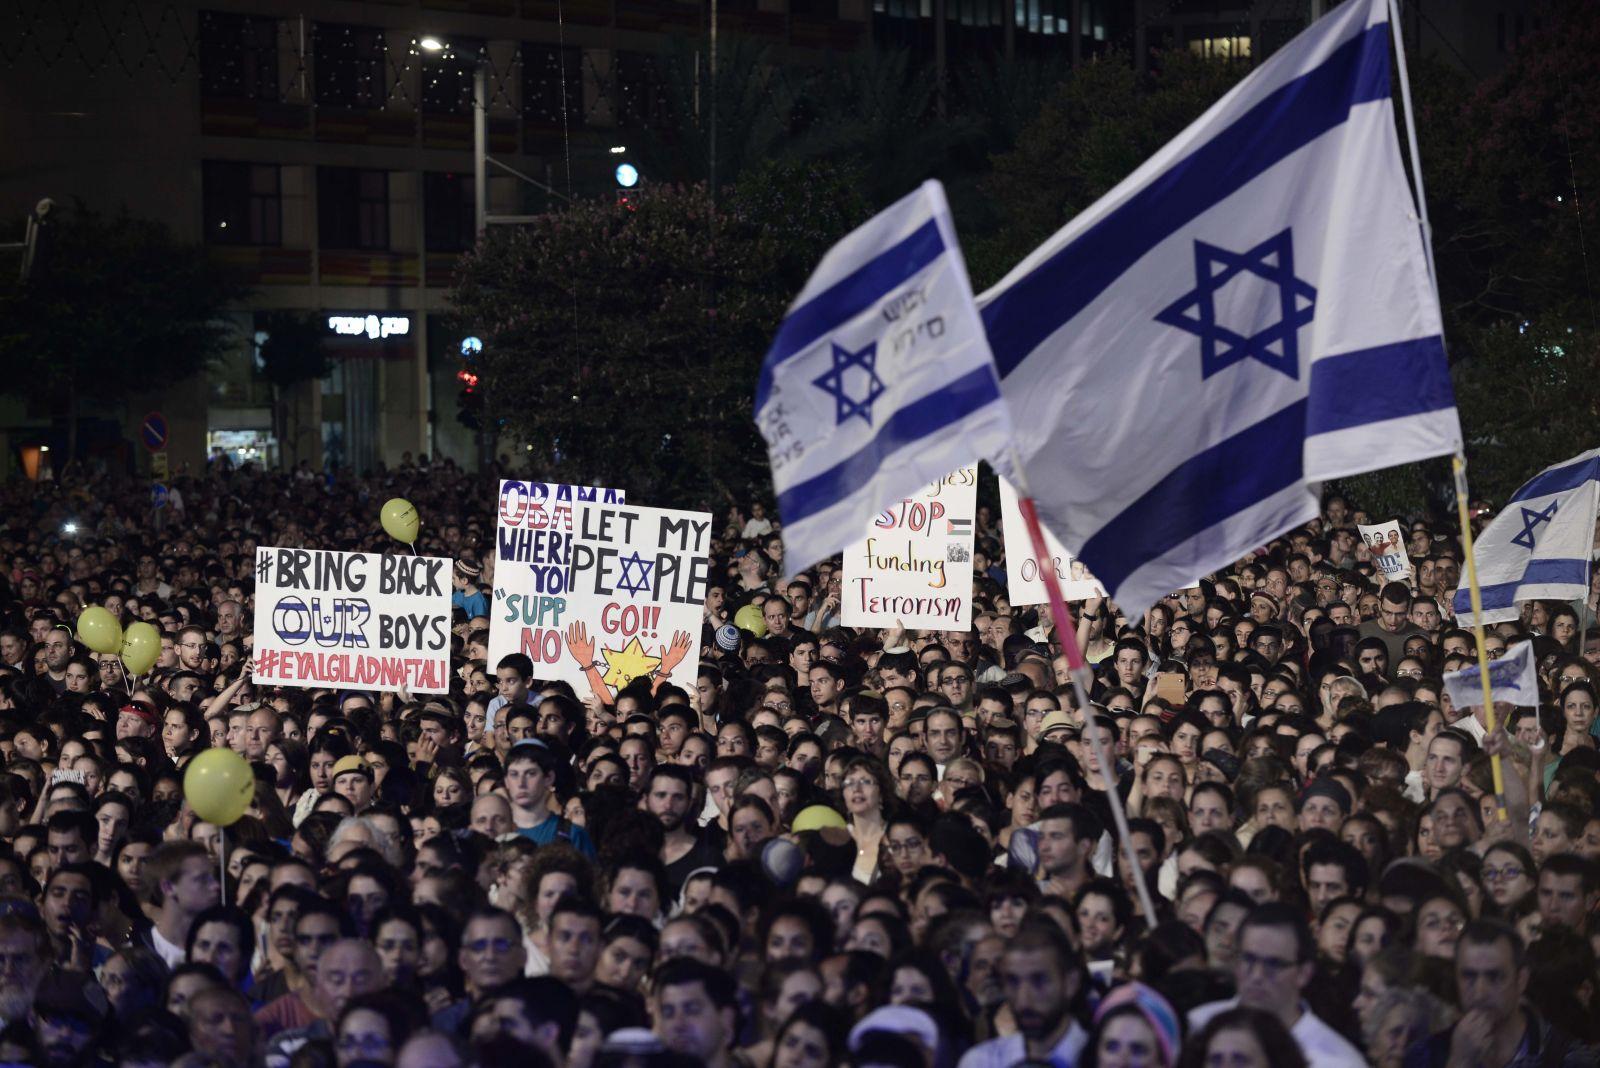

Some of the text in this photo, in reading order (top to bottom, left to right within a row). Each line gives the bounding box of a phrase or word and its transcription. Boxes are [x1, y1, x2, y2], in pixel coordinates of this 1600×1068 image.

[581, 507, 710, 551] LET MY
[875, 498, 945, 537] STOP
[257, 549, 444, 596] #BRING BACK
[864, 538, 947, 588] funding
[601, 602, 661, 639] GO!!
[852, 577, 961, 622] Terrorism
[272, 595, 447, 650] OUR BOYS
